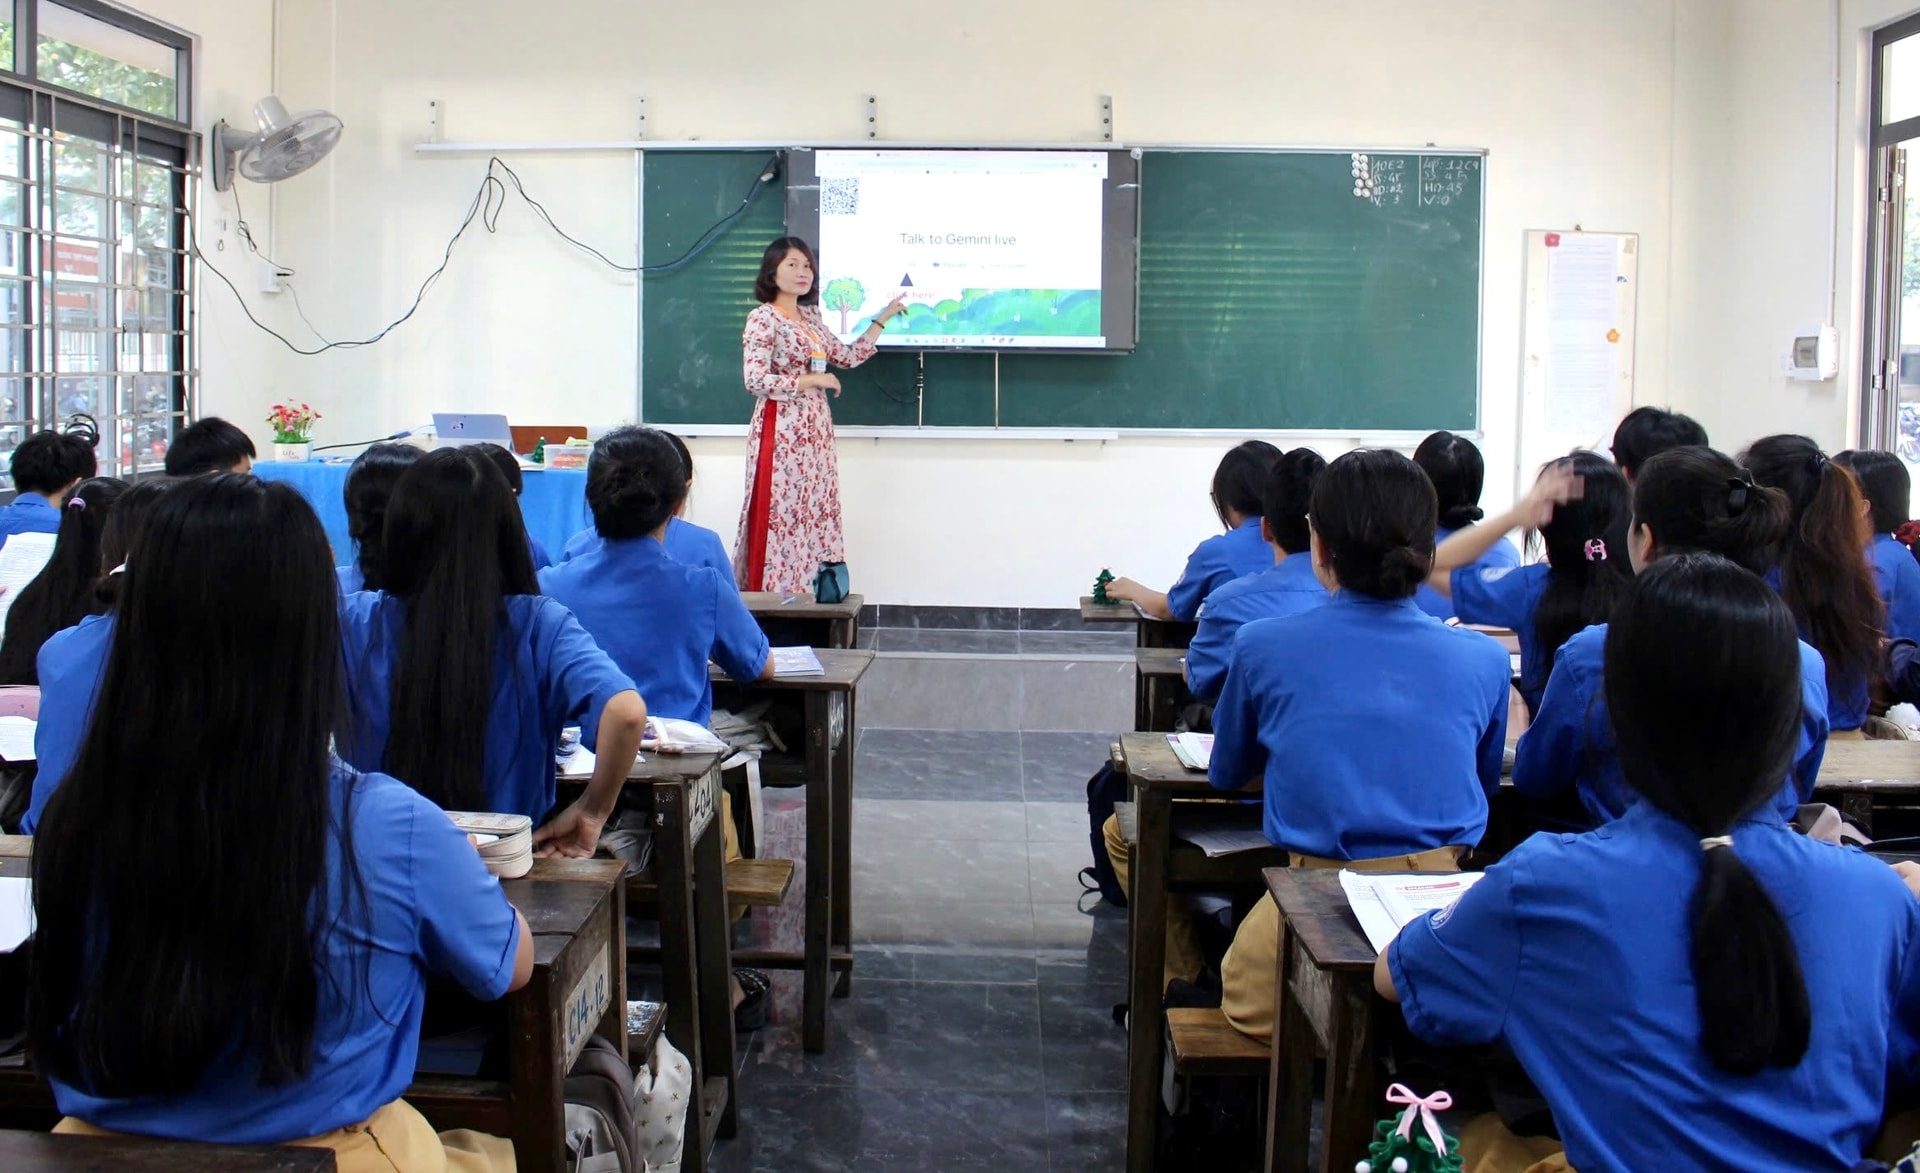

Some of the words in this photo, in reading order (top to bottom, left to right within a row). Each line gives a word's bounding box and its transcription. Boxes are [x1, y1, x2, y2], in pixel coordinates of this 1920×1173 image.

[900, 233, 925, 245] Talk
[929, 234, 943, 245] to
[946, 233, 991, 245] Gemini
[995, 234, 1017, 245] live
[887, 290, 909, 299] cli
[912, 291, 934, 299] here
